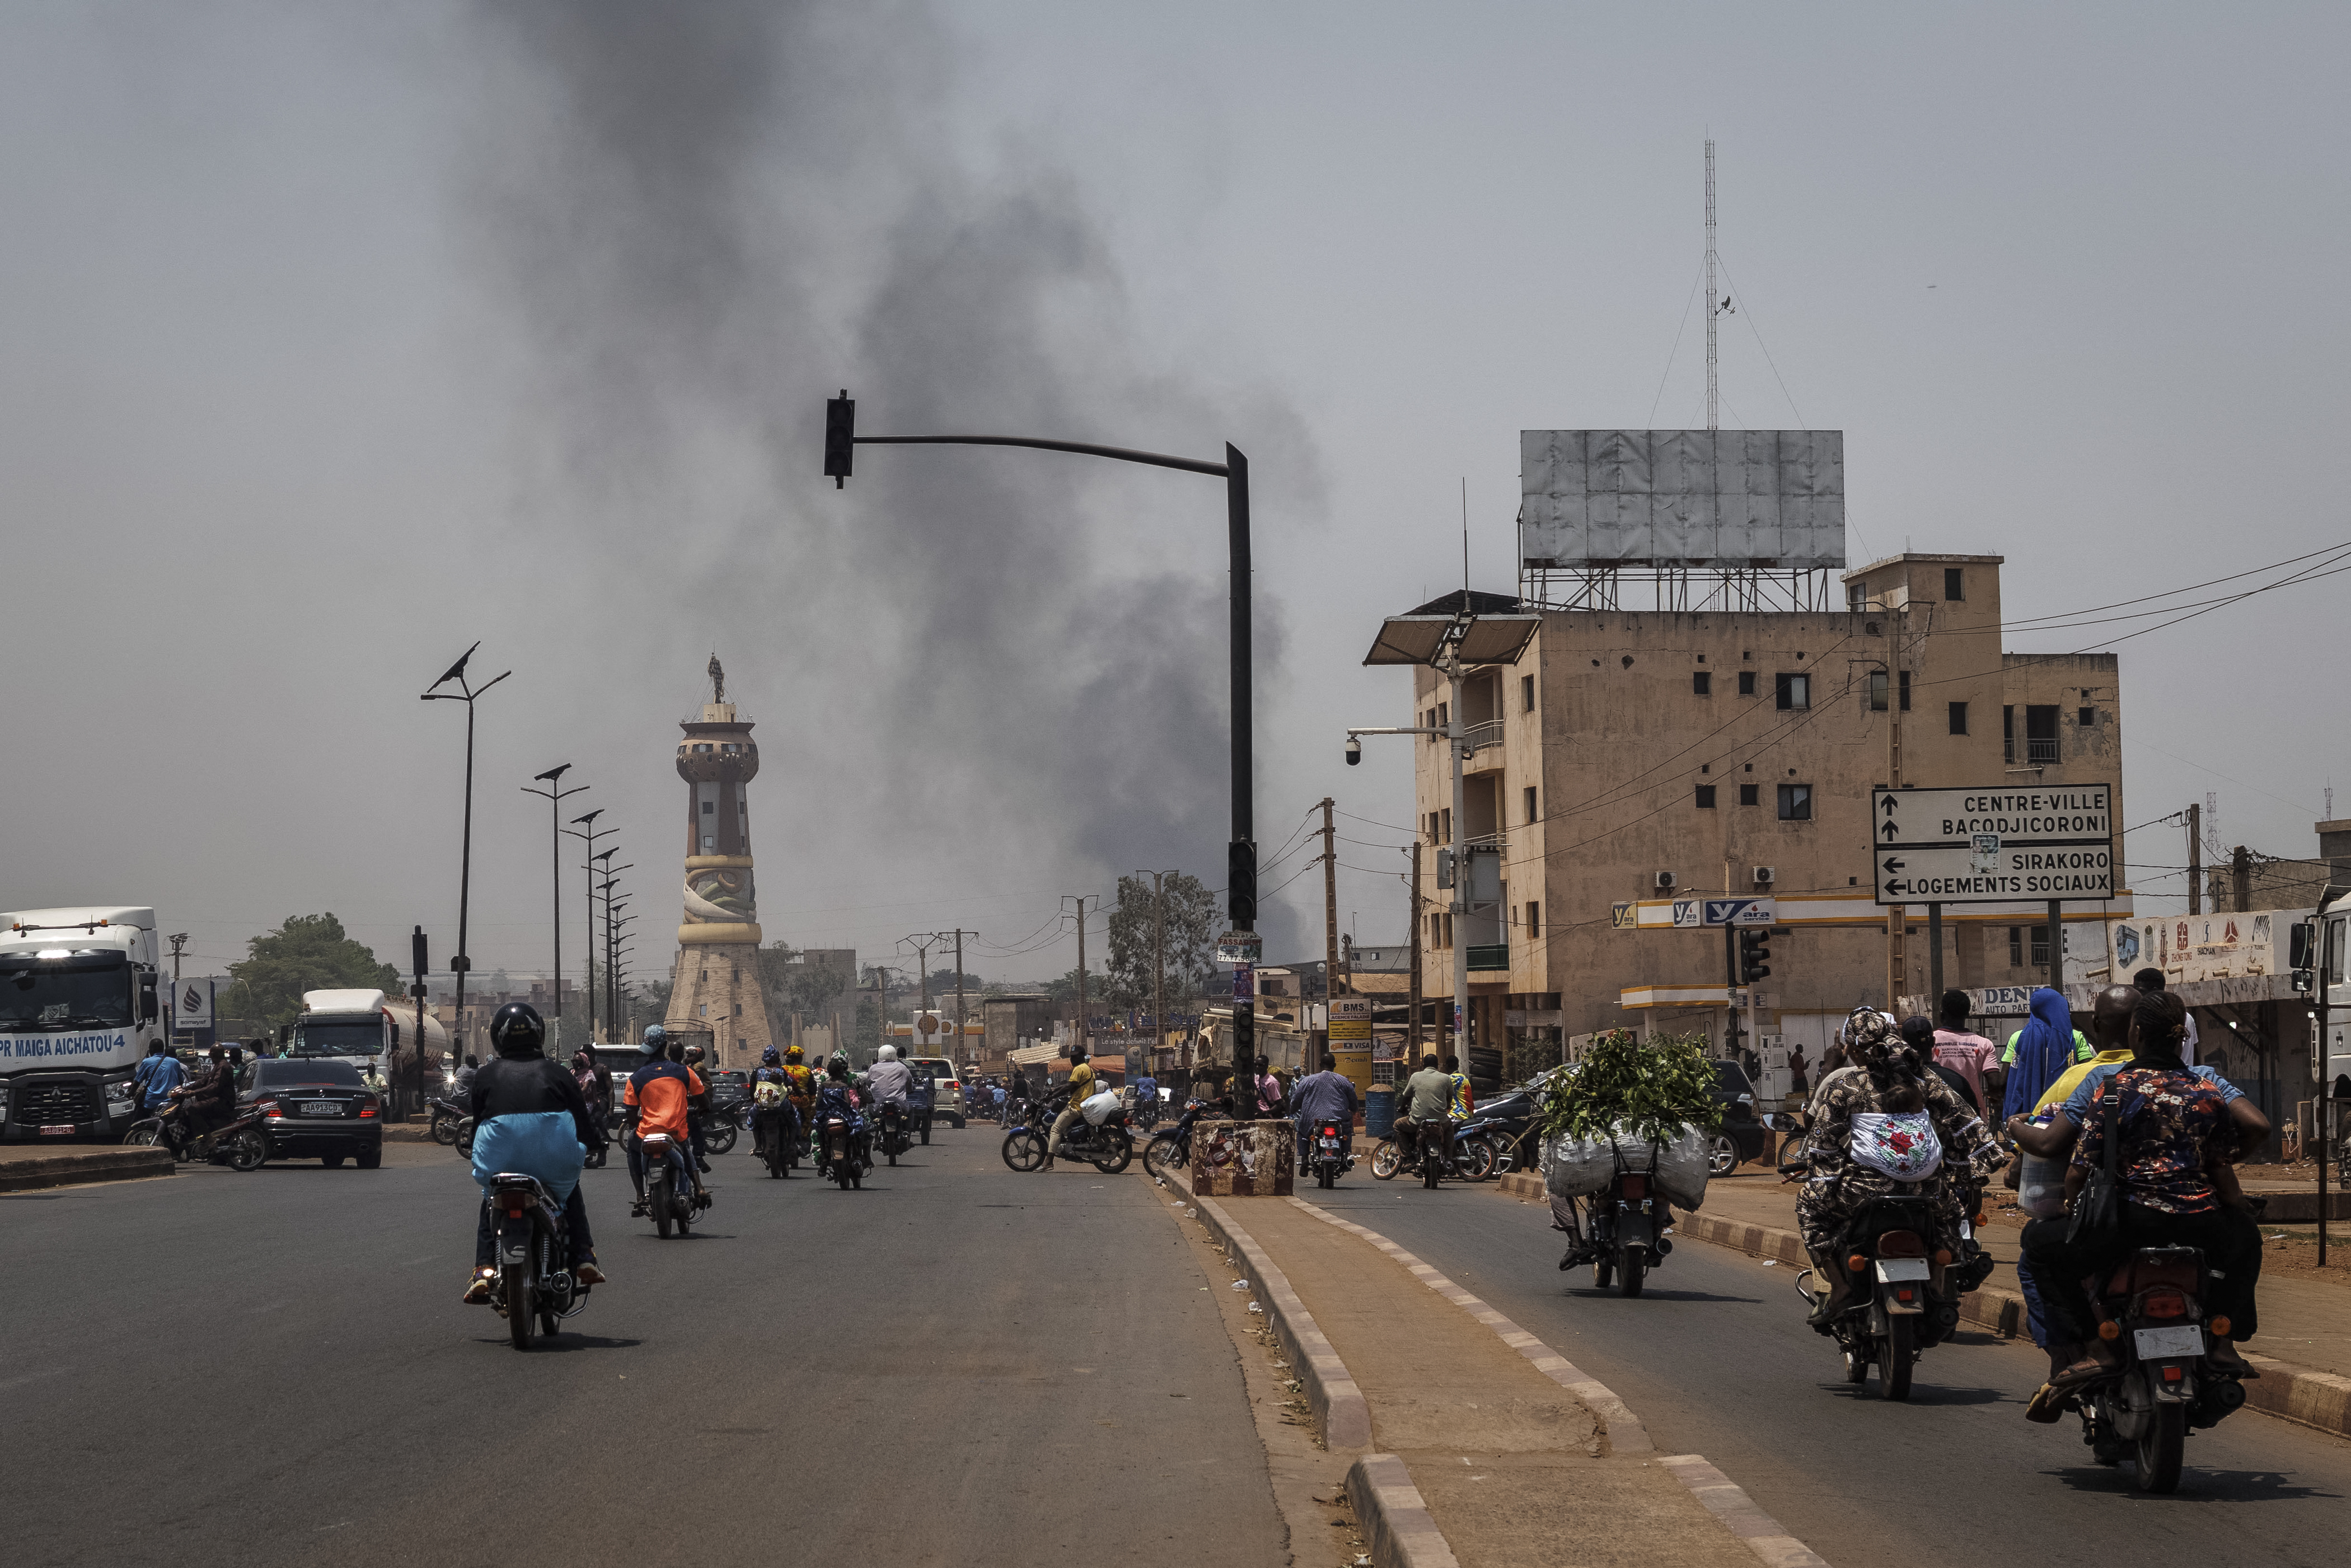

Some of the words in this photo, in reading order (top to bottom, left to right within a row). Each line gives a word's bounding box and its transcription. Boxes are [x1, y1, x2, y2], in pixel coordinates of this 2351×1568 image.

[1965, 793, 2105, 812] CENTRE-VILLE
[1943, 815, 2106, 835] BACODJICORONI
[2012, 852, 2108, 870] SIRAKORO
[1907, 876, 2021, 895] LOGEMENTS
[2026, 874, 2109, 891] SOCIAUX
[1985, 1005, 2006, 1014] AUTO
[16, 1039, 52, 1057] MAIGA
[55, 1035, 112, 1055] AICHATOU
[114, 1035, 125, 1047] 4
